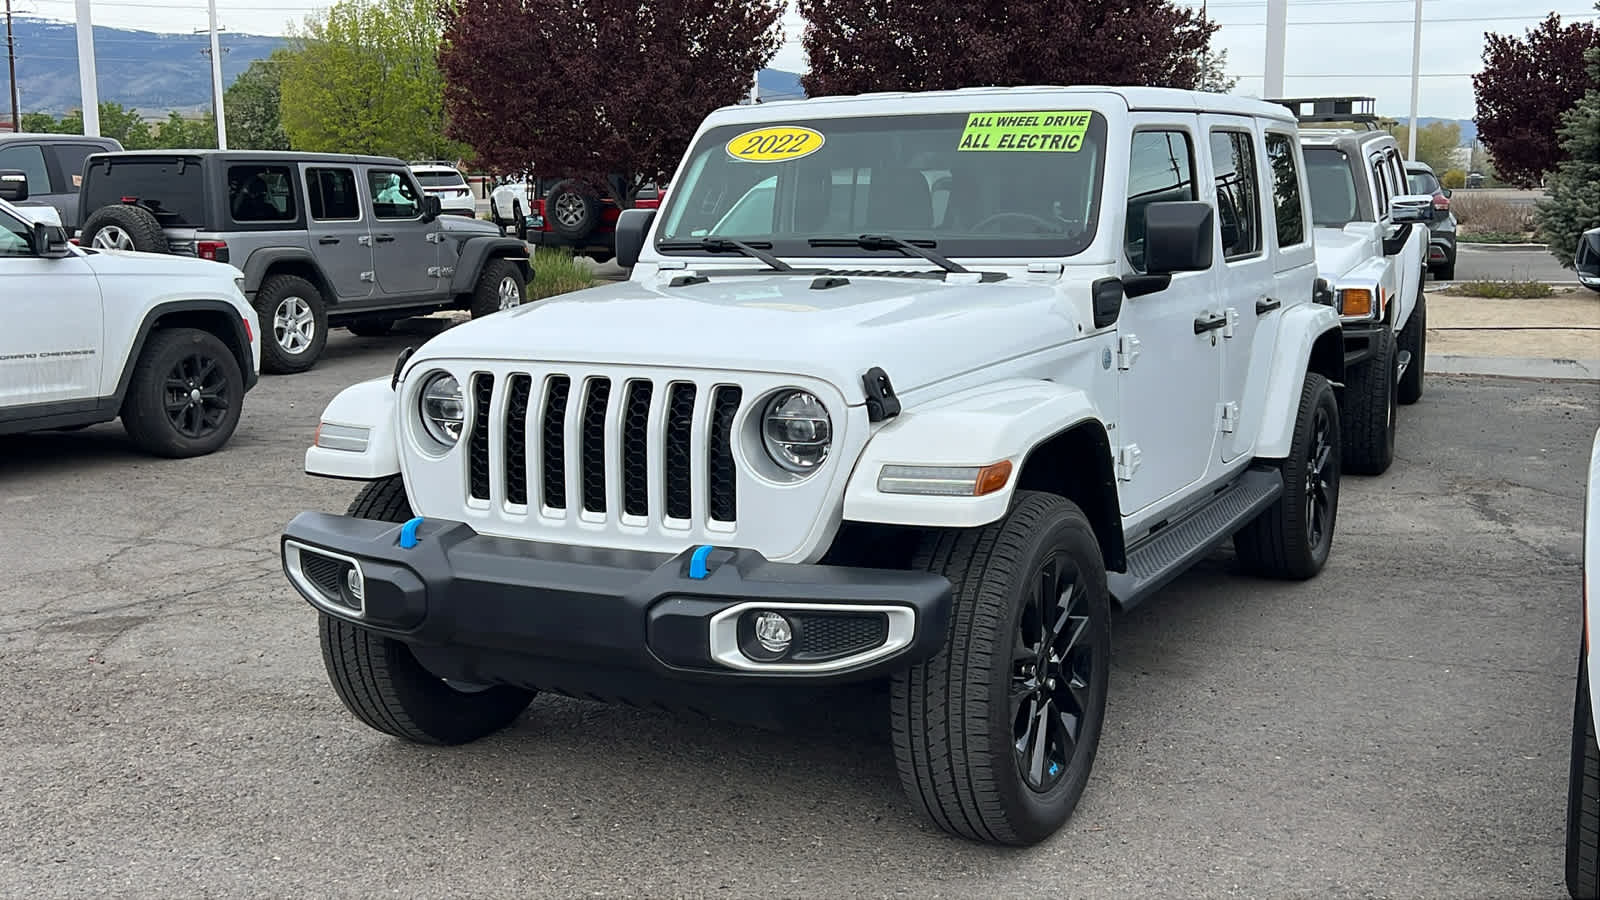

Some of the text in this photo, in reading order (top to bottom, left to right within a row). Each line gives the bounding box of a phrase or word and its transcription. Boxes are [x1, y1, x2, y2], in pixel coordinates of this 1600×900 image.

[968, 115, 1088, 128] ALL WHEEL DRIVE
[739, 133, 810, 155] 2022
[960, 134, 1081, 149] ALL ELECTRIC
